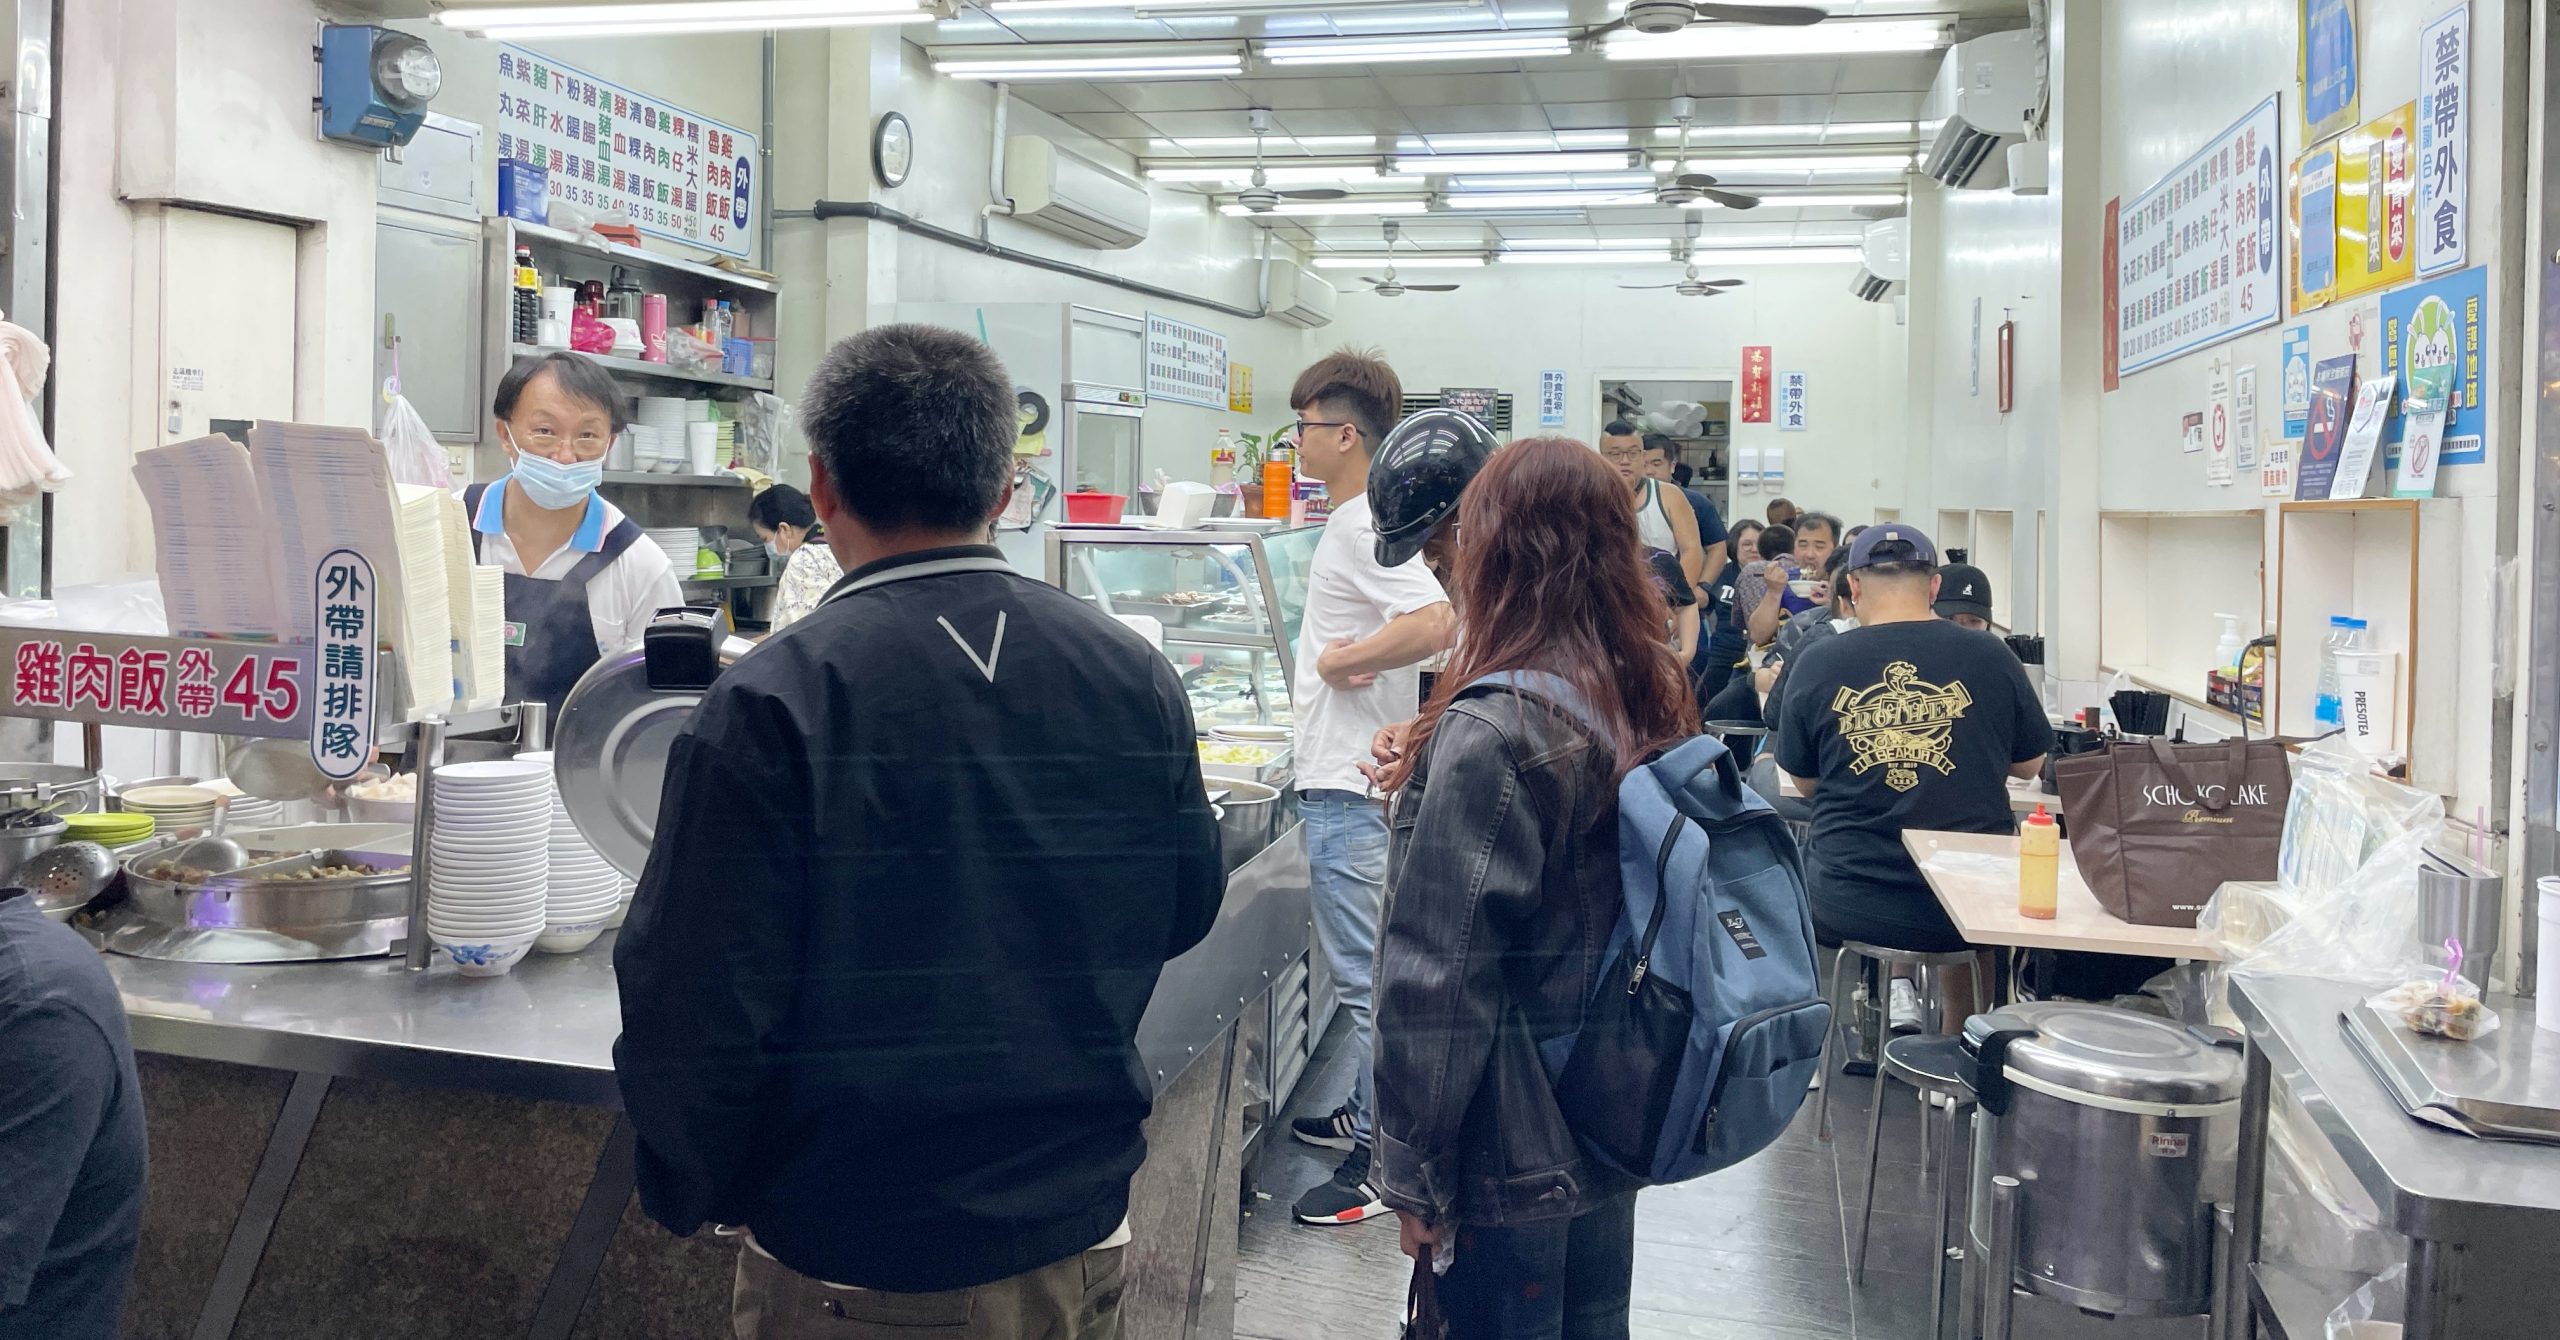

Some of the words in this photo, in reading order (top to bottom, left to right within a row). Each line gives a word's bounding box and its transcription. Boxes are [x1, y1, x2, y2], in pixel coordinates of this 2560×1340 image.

[549, 70, 565, 173] 下水湯
[566, 76, 581, 178] 粉腸湯
[2434, 25, 2459, 255] 禁帶外食
[643, 107, 656, 200] 魯肉飯
[657, 111, 671, 205] 雞肉飯
[706, 130, 720, 218] 魯肉飯
[550, 180, 562, 197] 30
[566, 185, 578, 202] 35
[582, 189, 594, 206] 35
[718, 133, 733, 222] 雞肉飯
[735, 167, 748, 219] 外帶
[597, 193, 609, 210] 35
[628, 202, 640, 218] 35
[642, 206, 654, 222] 35
[657, 210, 668, 226] 35
[671, 214, 682, 229] 50
[710, 223, 725, 243] 45
[2240, 282, 2253, 313] 45
[1789, 375, 1803, 426] 禁帶外食
[15, 641, 169, 715] 雞肉飯
[177, 648, 217, 717] 外帶
[222, 656, 301, 722] 45
[321, 565, 365, 760] 外帶請排隊
[2354, 690, 2369, 737] PRESOTEA
[2182, 809, 2234, 823] Premium
